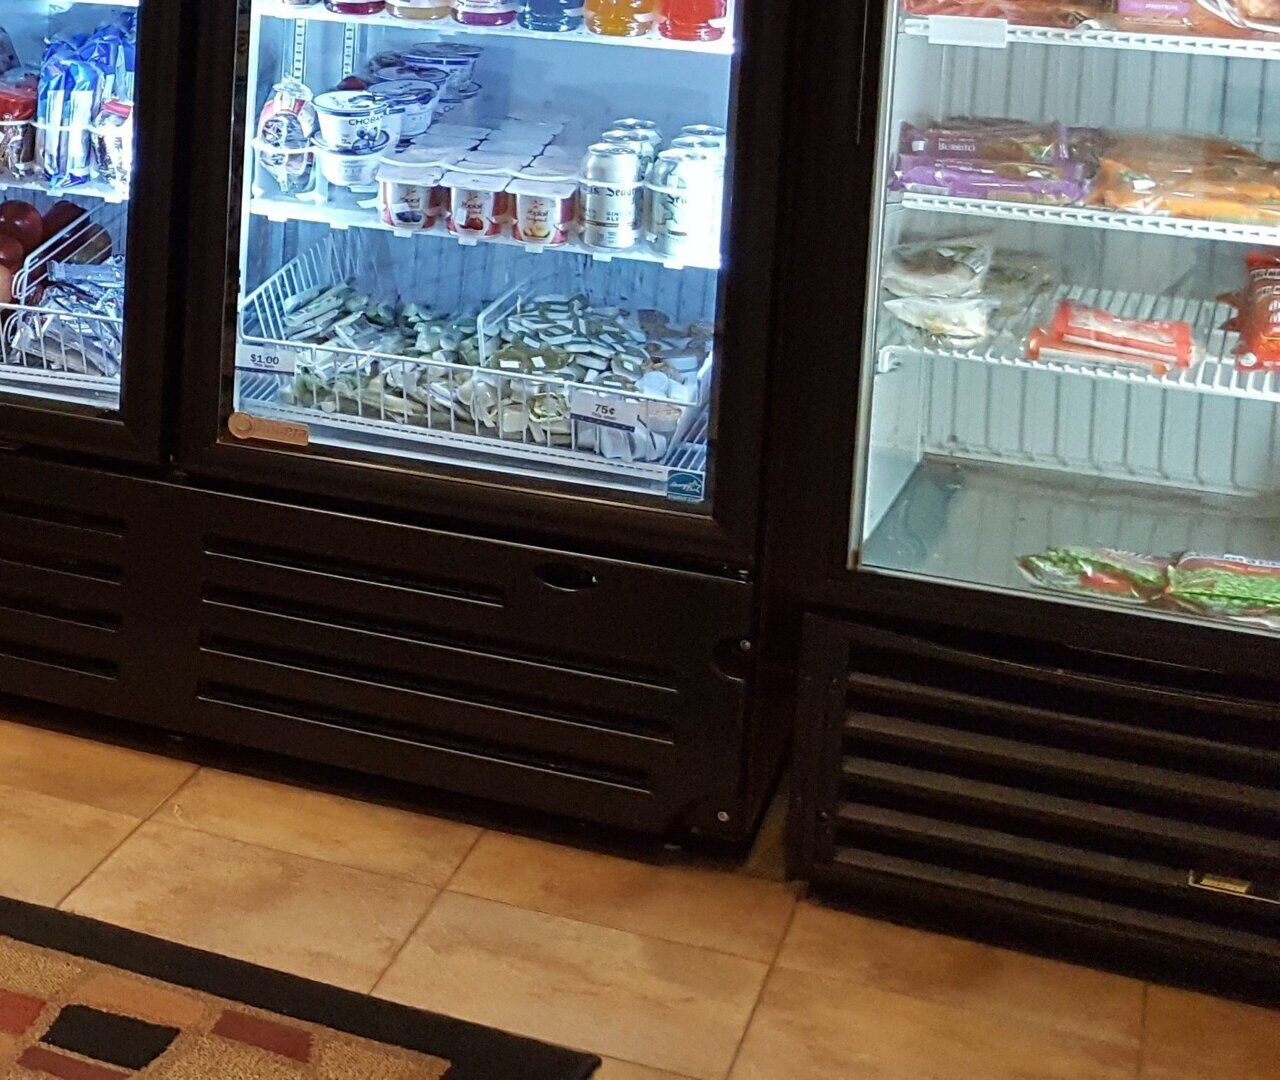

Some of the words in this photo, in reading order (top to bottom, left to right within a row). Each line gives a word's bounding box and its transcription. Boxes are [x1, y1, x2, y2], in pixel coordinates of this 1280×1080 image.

[937, 141, 976, 152] BURRITO
[250, 353, 280, 366] $1.00
[595, 403, 616, 415] 75¢
